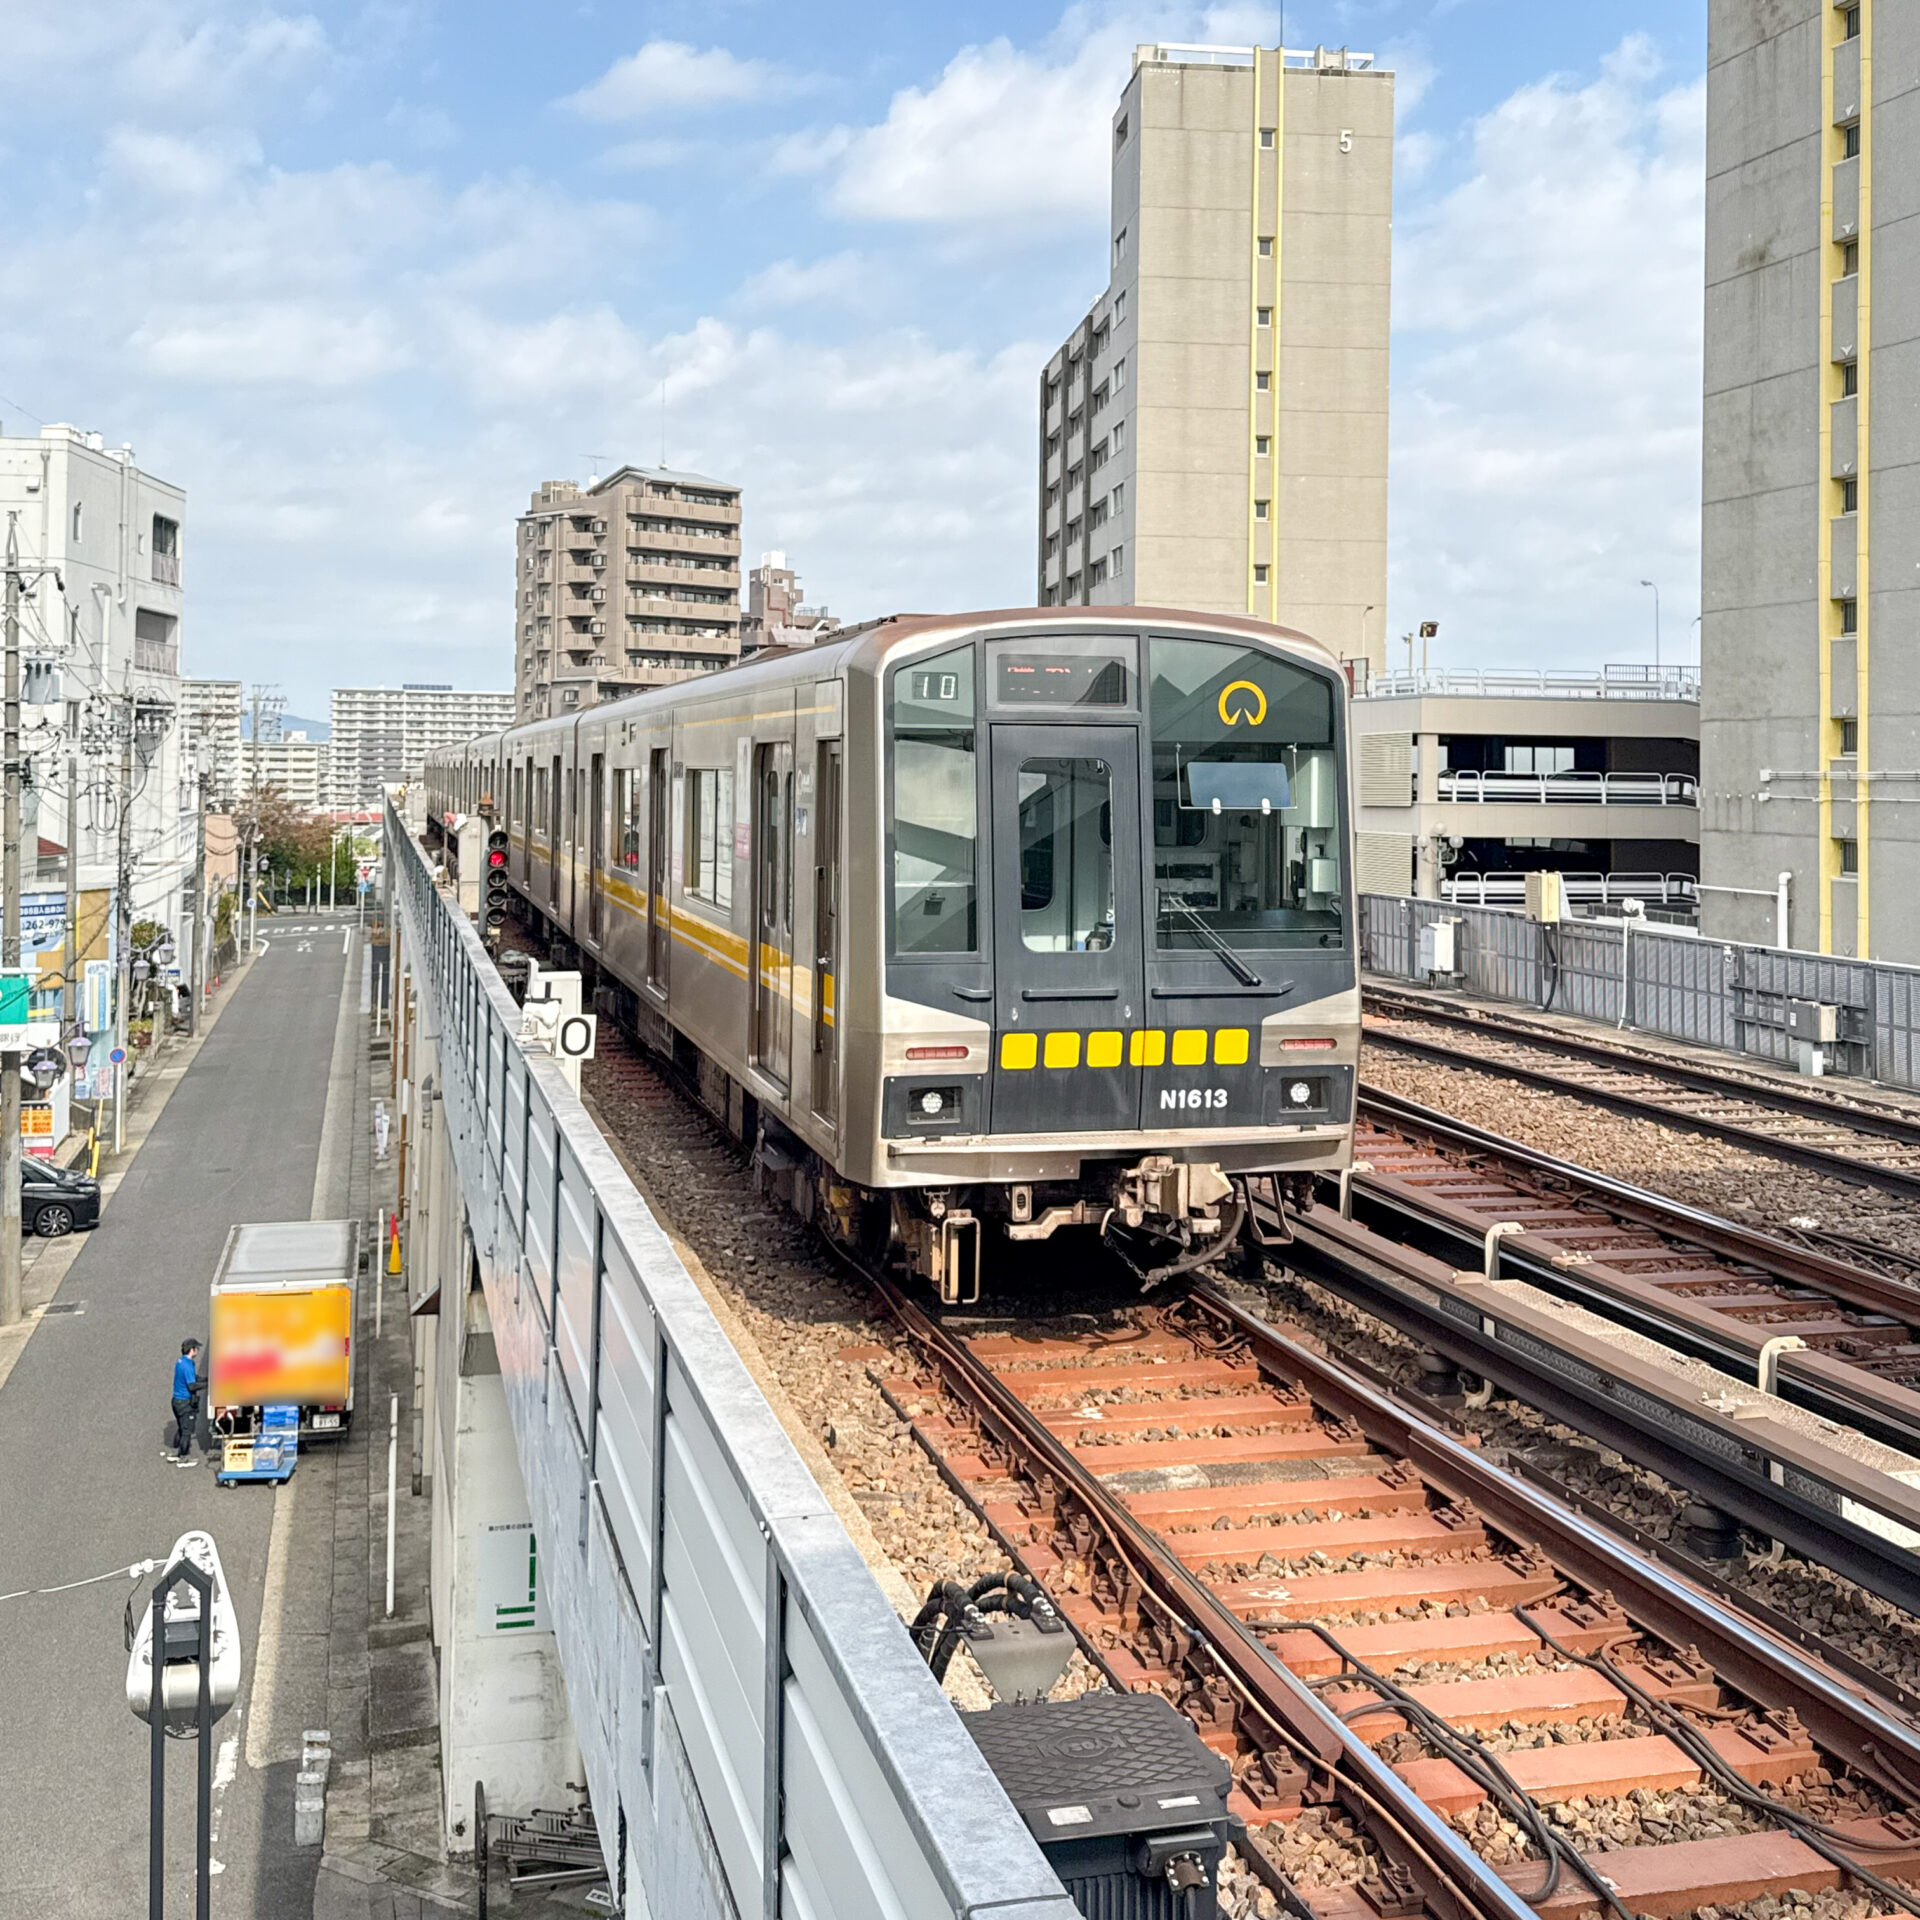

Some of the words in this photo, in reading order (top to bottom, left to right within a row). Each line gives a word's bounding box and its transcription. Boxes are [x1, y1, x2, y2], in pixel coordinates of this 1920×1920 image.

[1340, 129, 1352, 152] 5
[923, 675, 956, 699] 10
[1160, 1088, 1228, 1109] N1613
